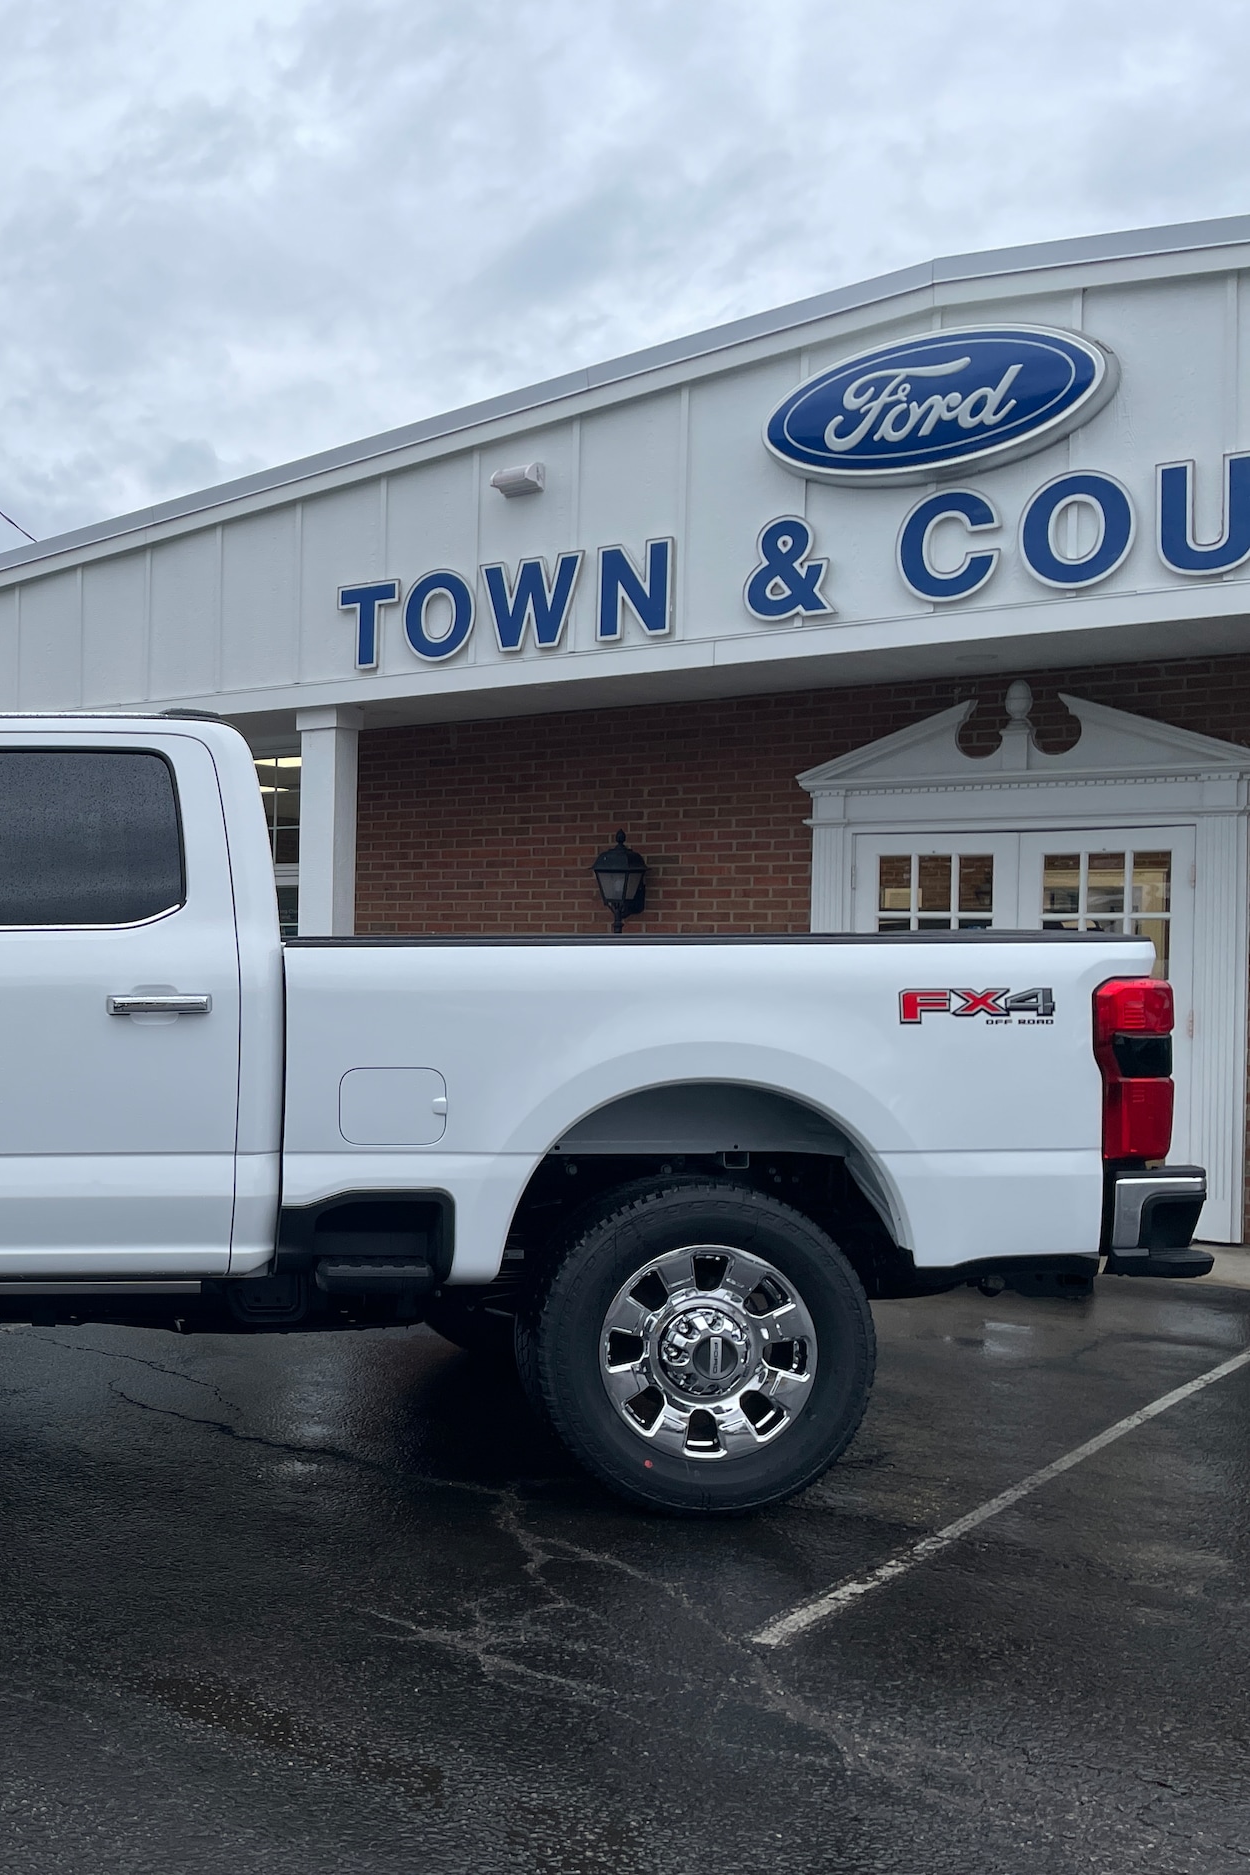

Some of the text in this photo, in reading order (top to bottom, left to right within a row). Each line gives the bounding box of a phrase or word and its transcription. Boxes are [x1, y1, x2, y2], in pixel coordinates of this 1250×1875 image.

[824, 356, 1023, 452] Ford
[338, 537, 672, 669] TOWN
[744, 516, 834, 620] &
[899, 988, 1055, 1025] FX4
